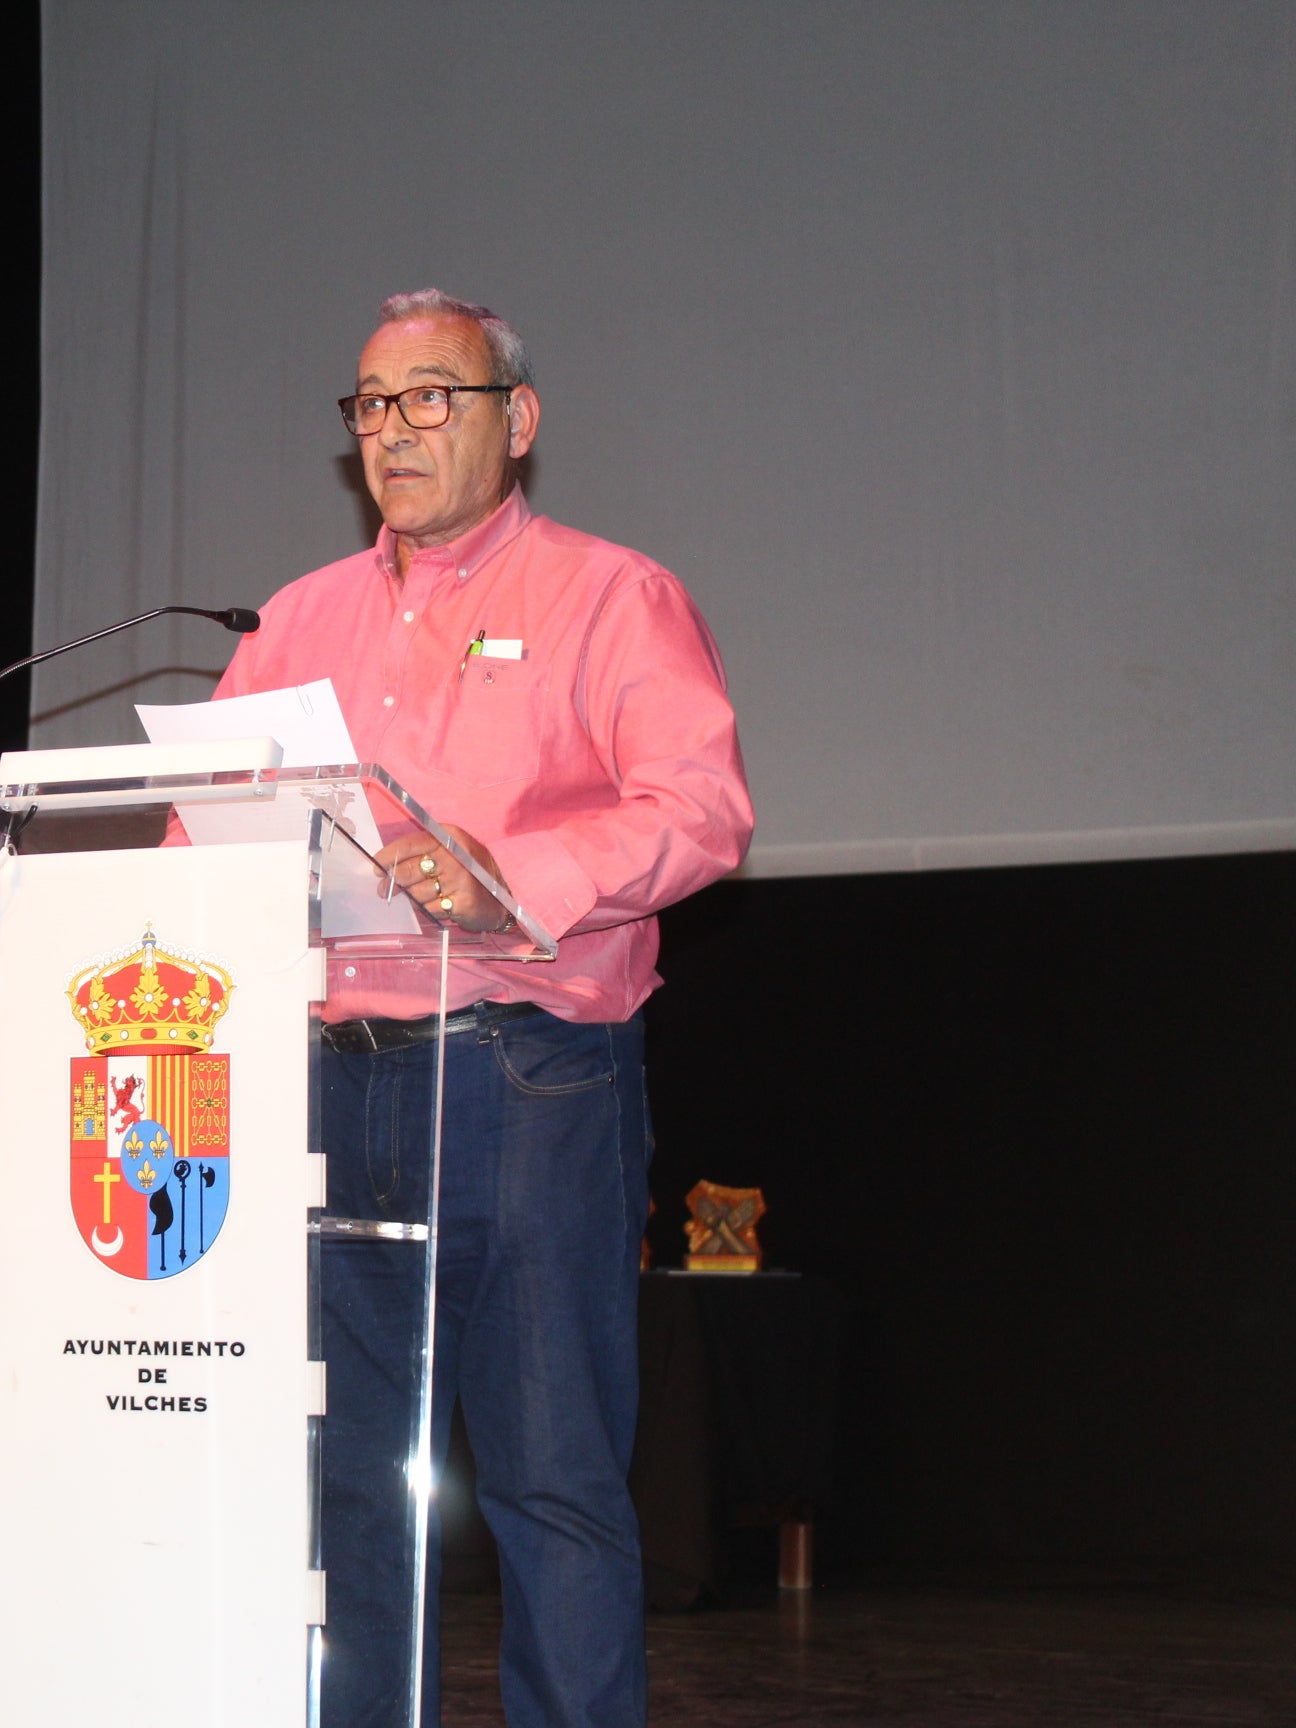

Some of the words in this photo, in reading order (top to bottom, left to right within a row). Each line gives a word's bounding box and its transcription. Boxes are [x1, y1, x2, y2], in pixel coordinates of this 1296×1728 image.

[63, 1339, 246, 1357] AYUNTAMIENTO
[137, 1368, 167, 1384] DE
[106, 1395, 208, 1412] VILCHES
